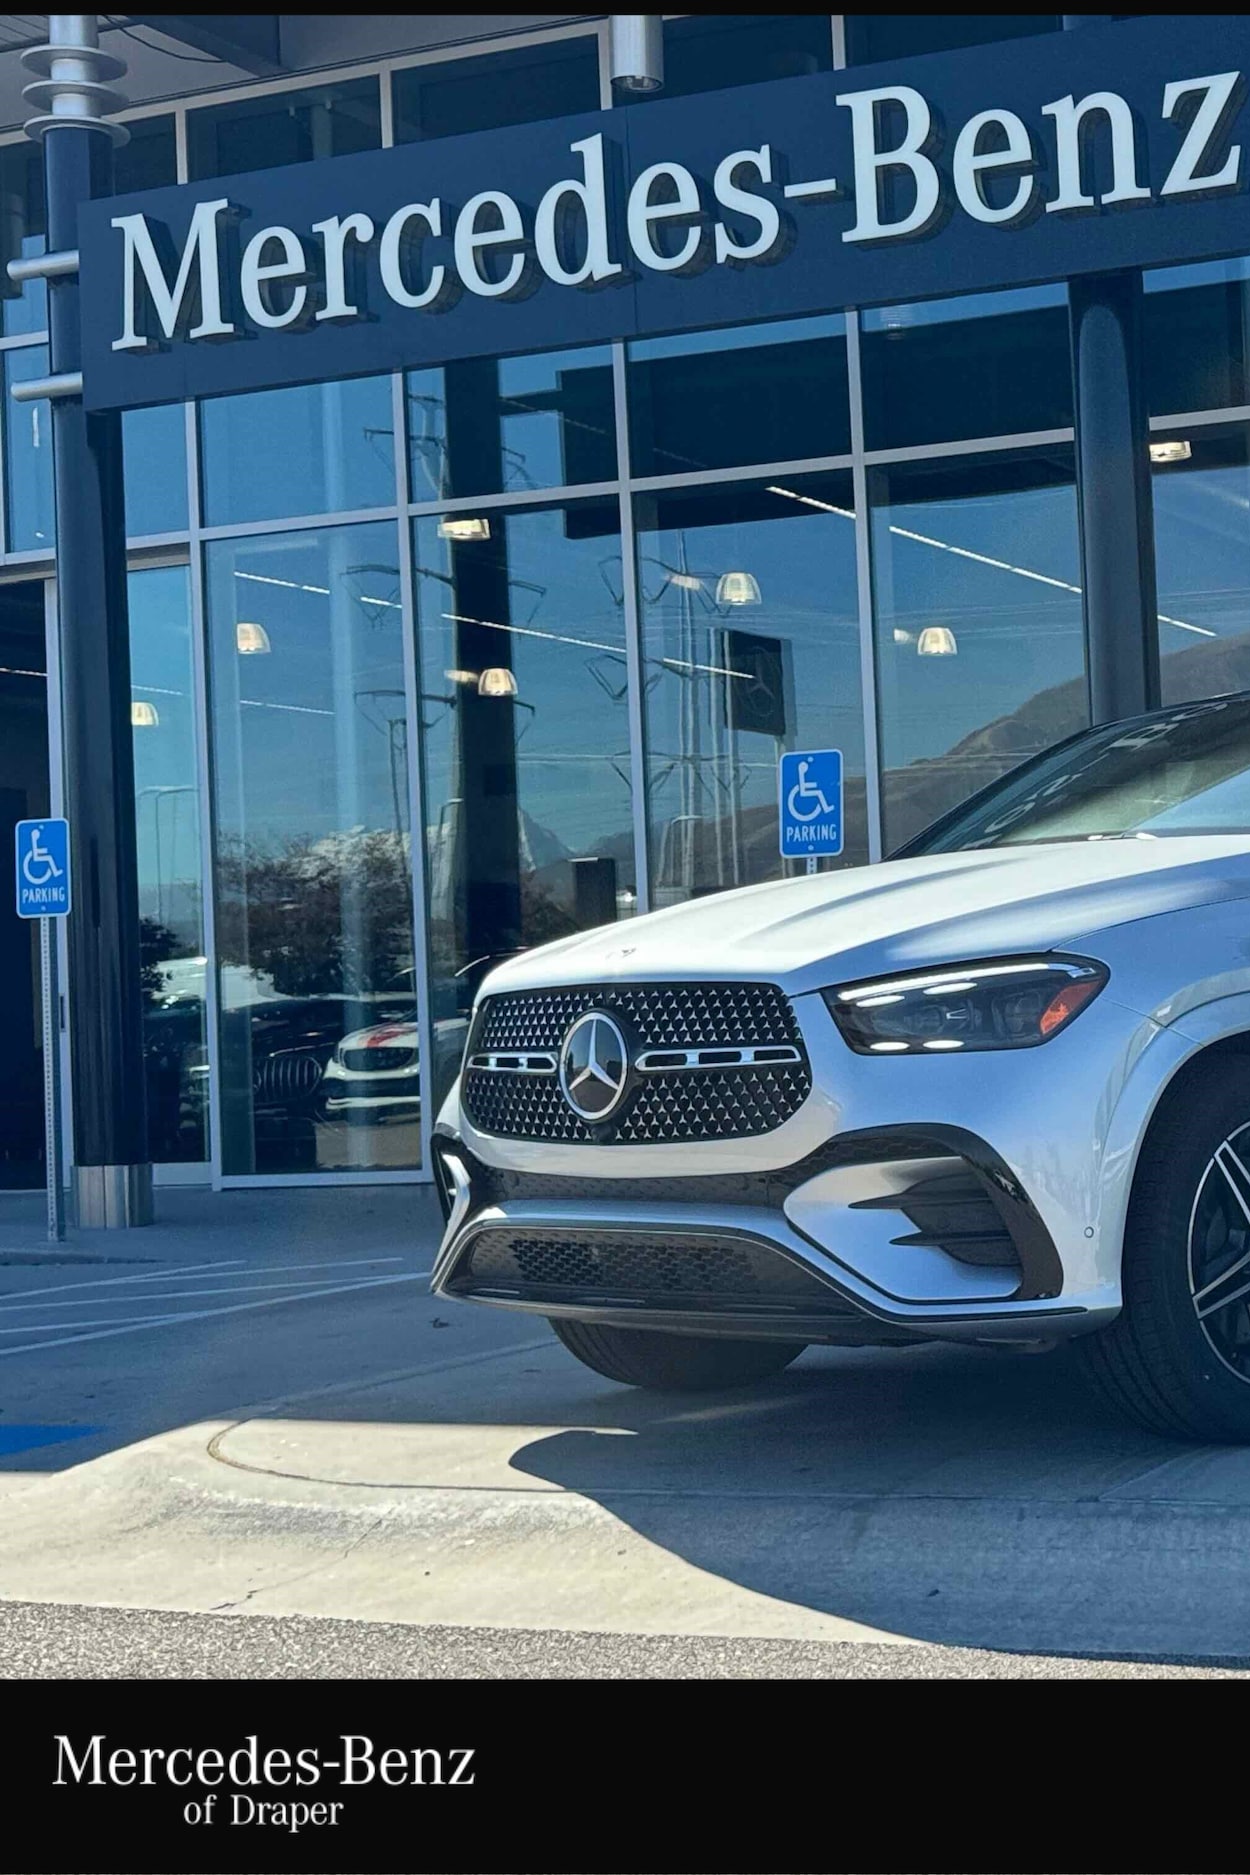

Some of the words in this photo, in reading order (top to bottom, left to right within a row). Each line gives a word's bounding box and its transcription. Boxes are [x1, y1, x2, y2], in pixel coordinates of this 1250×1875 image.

[111, 71, 1242, 351] Mercedes-Benz
[786, 824, 837, 842] PARKING
[22, 887, 65, 904] PARKING
